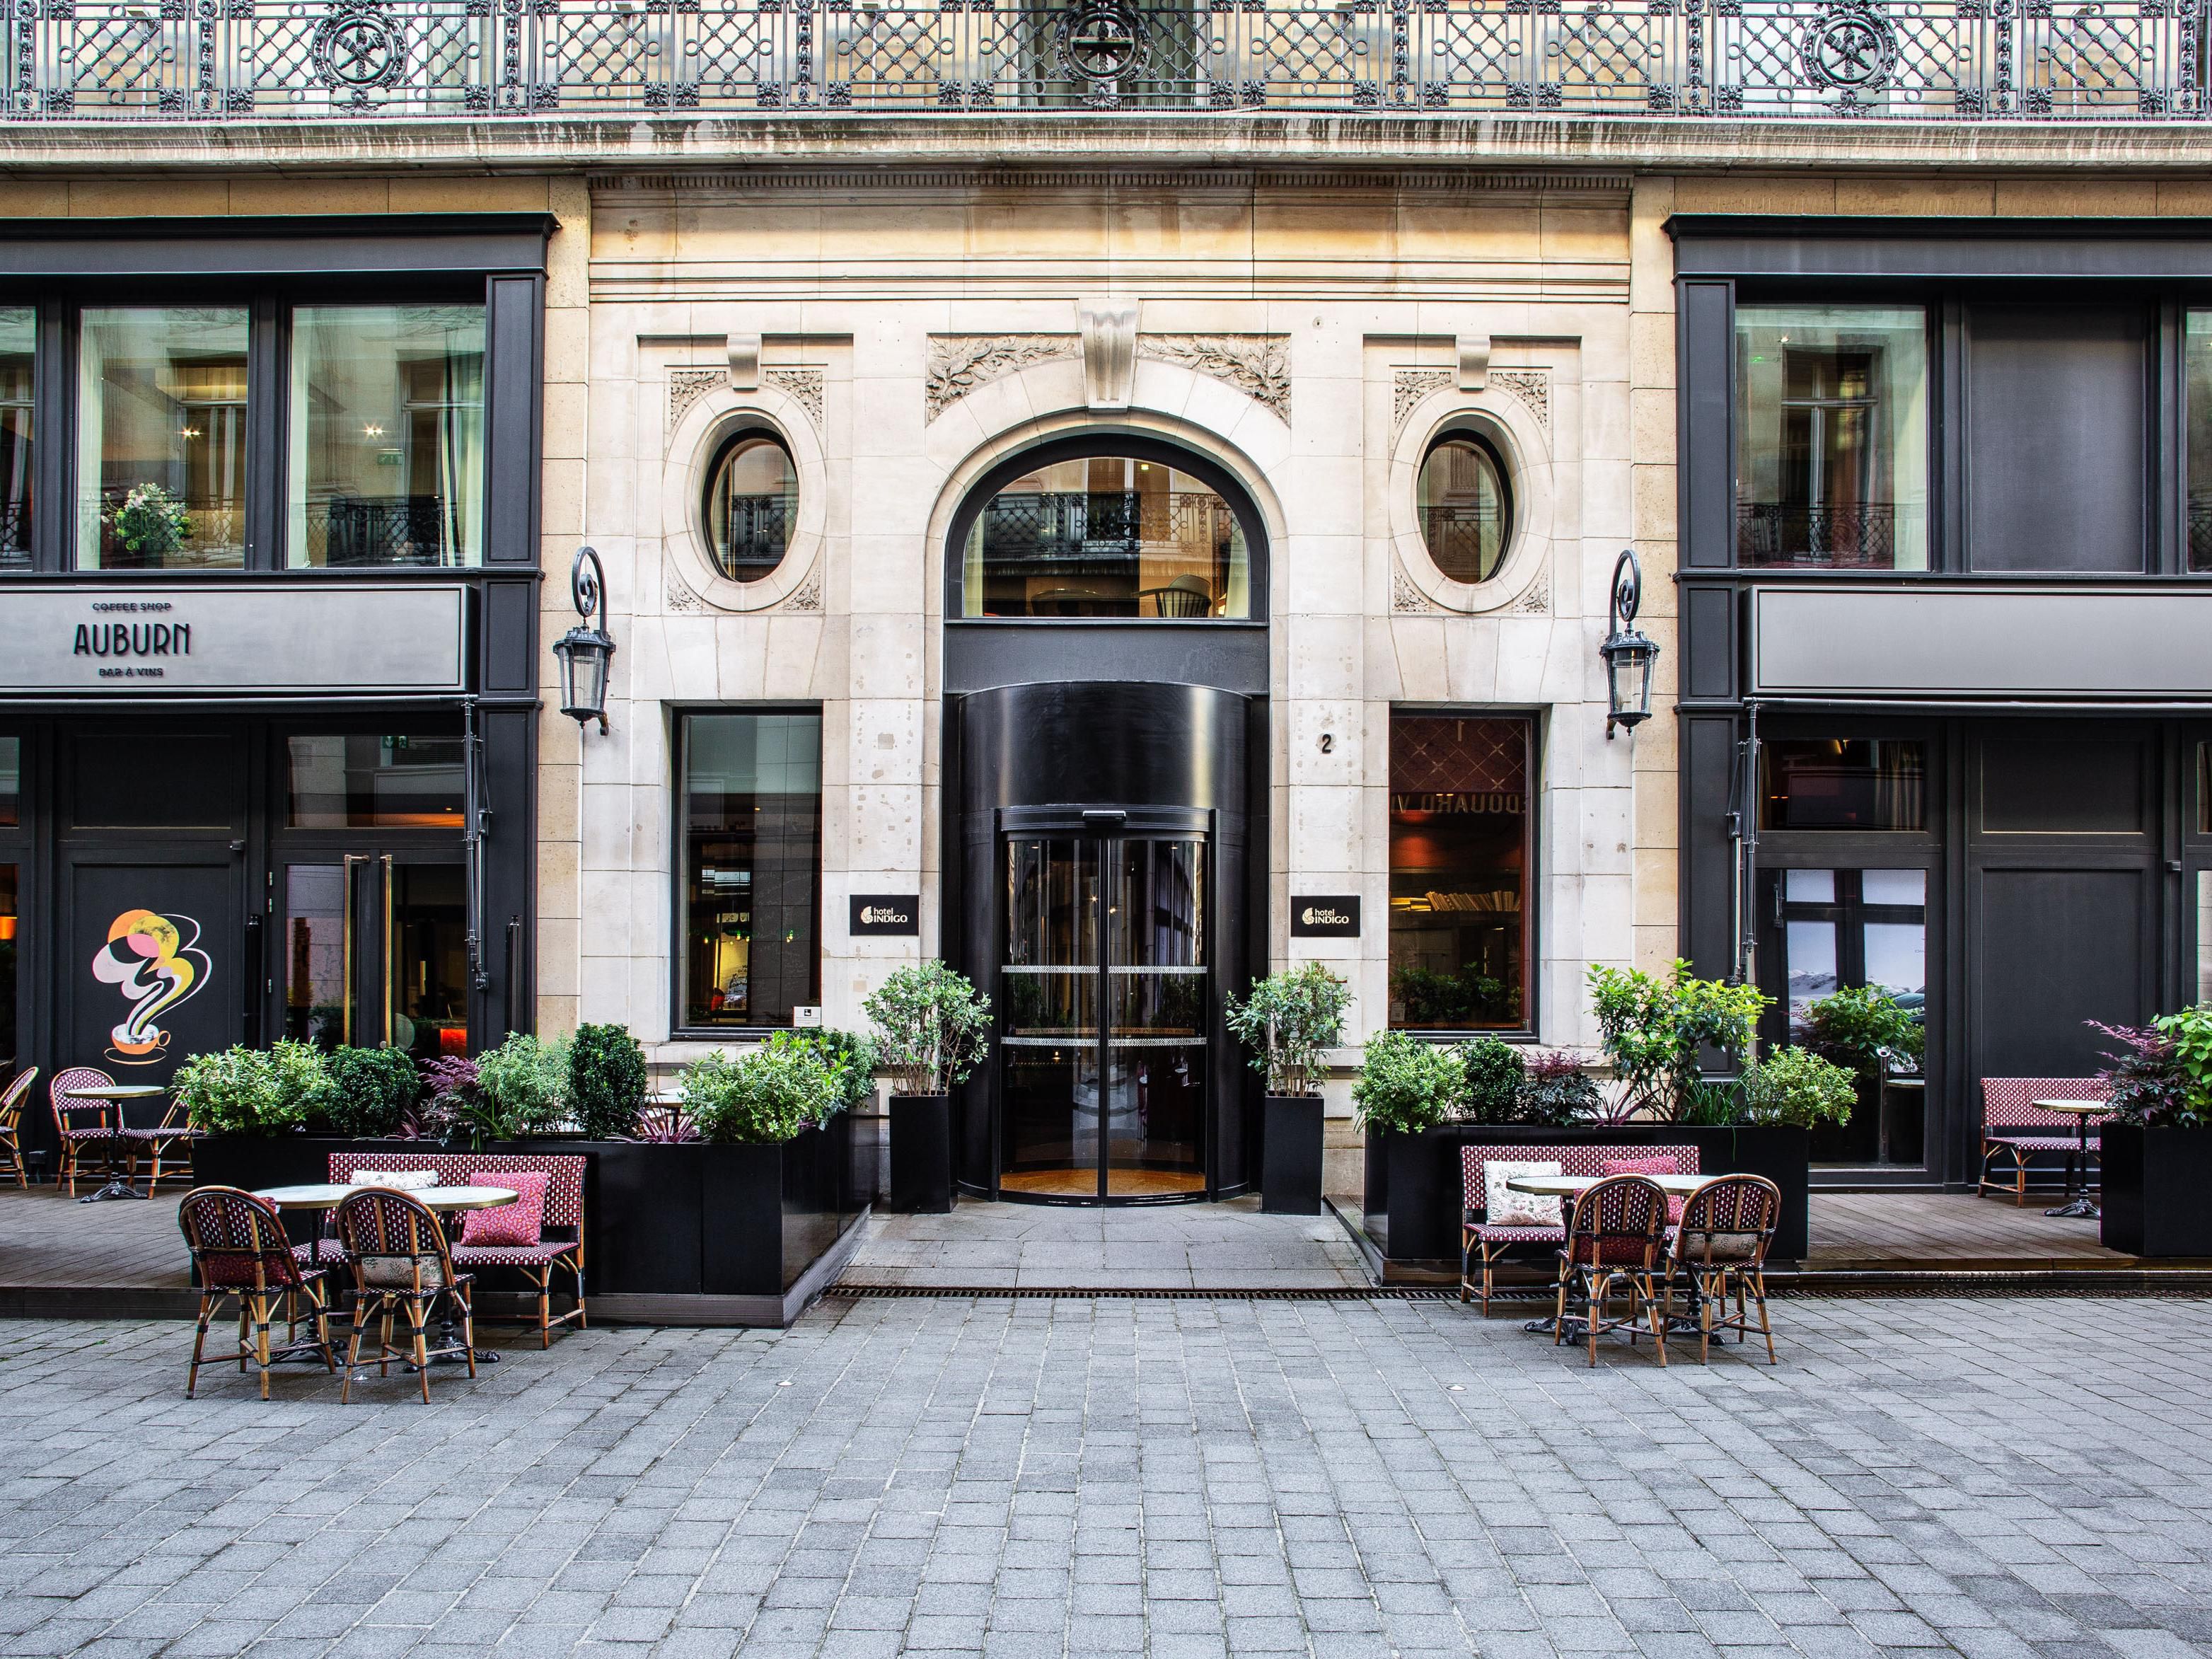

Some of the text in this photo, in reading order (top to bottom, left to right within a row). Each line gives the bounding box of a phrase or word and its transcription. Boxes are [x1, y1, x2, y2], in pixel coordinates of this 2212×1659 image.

[92, 603, 172, 612] COFFEE SHOP
[73, 623, 191, 656] AUBURN
[99, 666, 164, 677] BAR À VINS
[1321, 734, 1331, 754] 2
[873, 907, 893, 915] hotel
[873, 915, 908, 923] INDIGO
